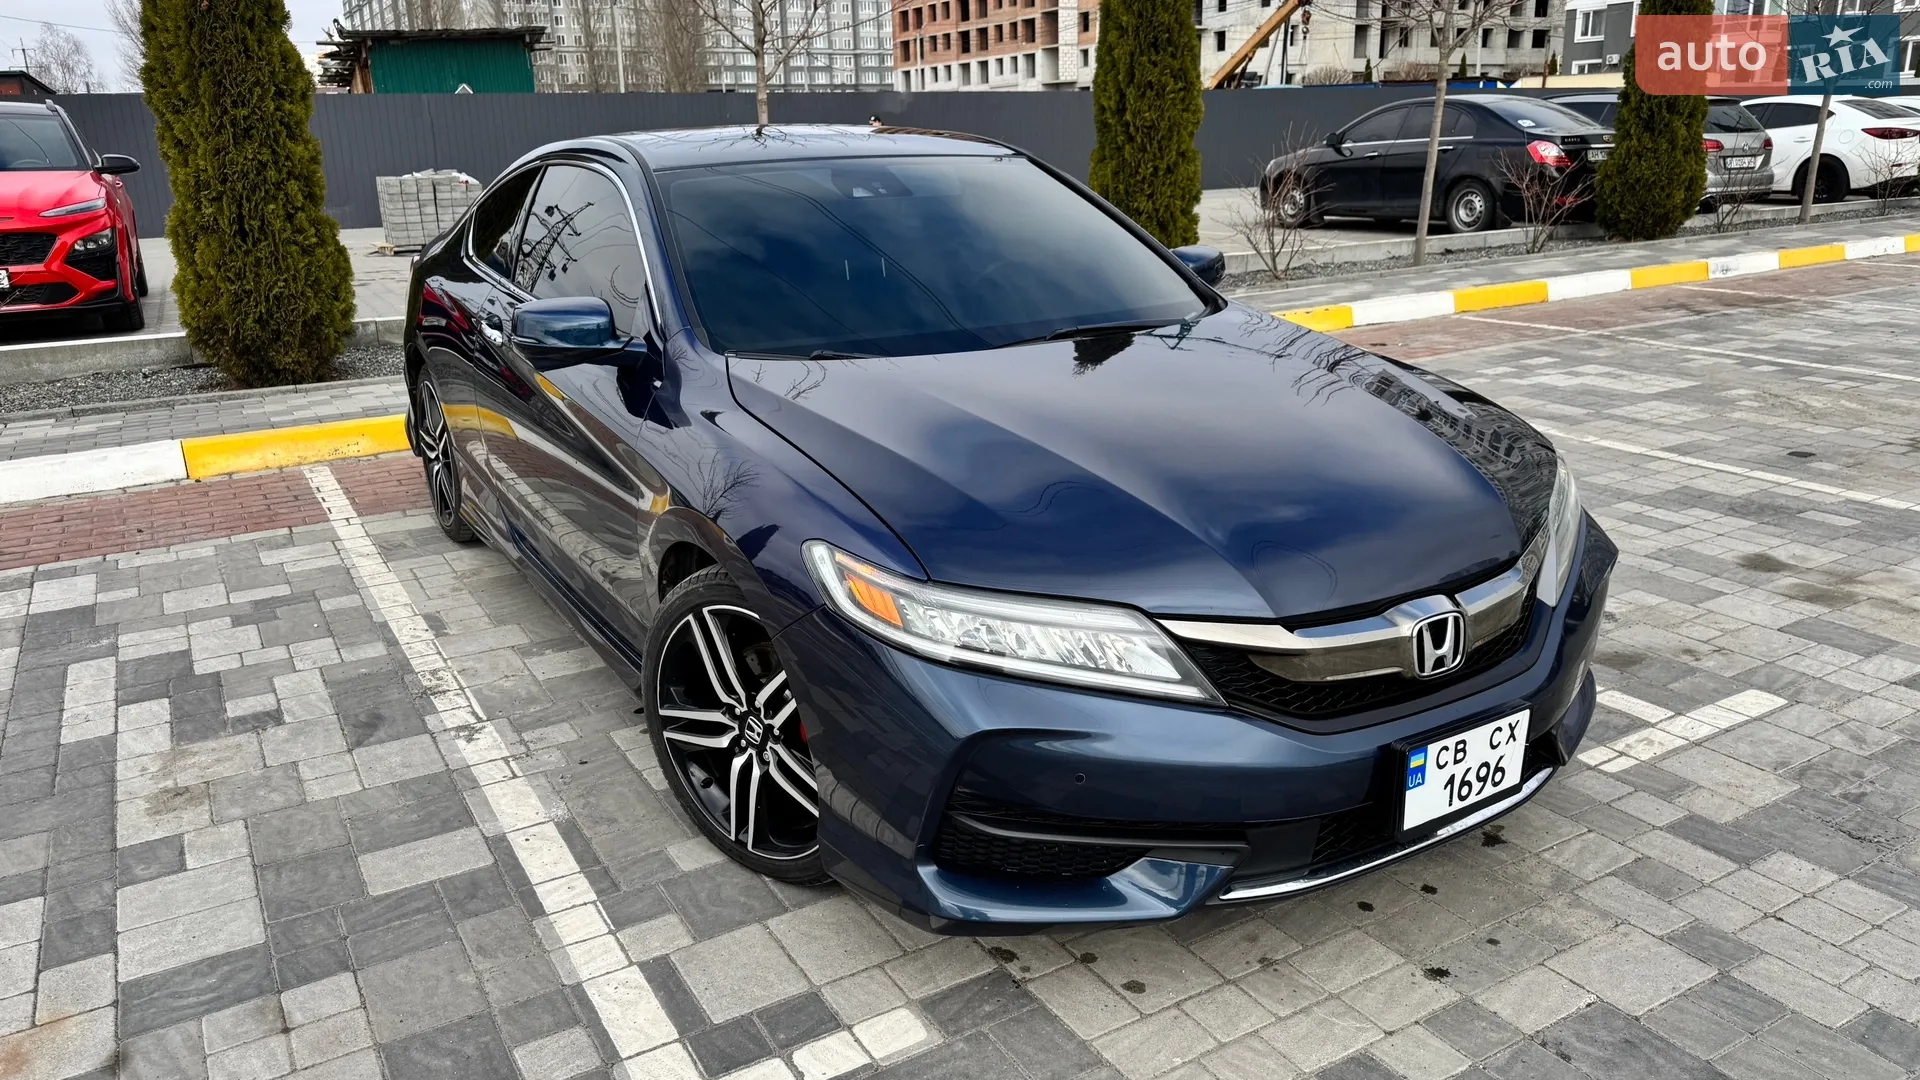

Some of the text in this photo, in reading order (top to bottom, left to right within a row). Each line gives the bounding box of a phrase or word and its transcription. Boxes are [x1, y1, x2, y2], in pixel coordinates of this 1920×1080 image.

[1436, 719, 1520, 770] CB CX
[1408, 774, 1423, 788] UA
[1443, 754, 1506, 807] 1696
